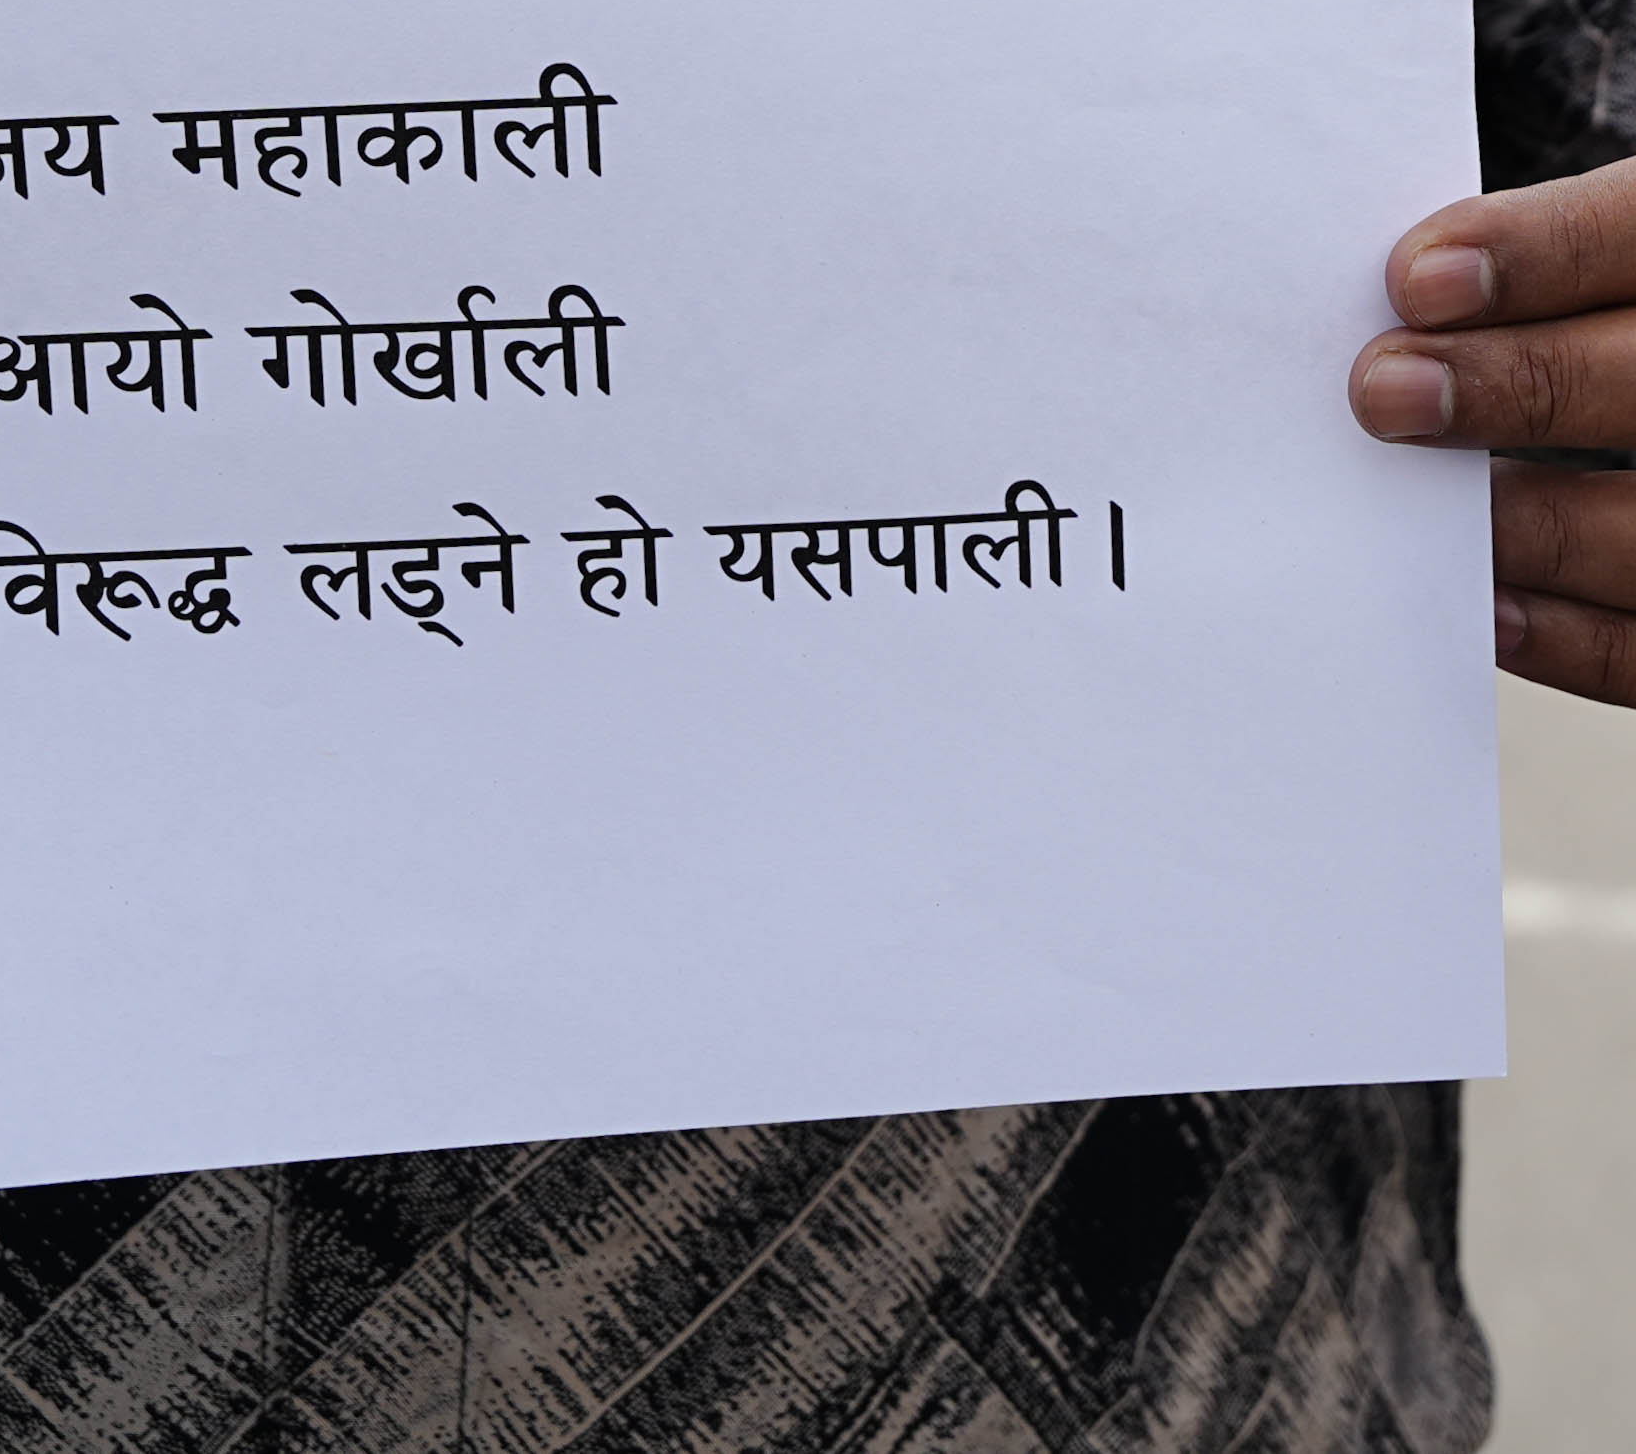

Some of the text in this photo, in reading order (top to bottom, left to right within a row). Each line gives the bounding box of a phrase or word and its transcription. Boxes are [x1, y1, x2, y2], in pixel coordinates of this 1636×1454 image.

[152, 62, 619, 198] महाकाली
[243, 284, 627, 408] गोर्खाली
[282, 502, 531, 648] लड्ने
[559, 494, 674, 618] हो
